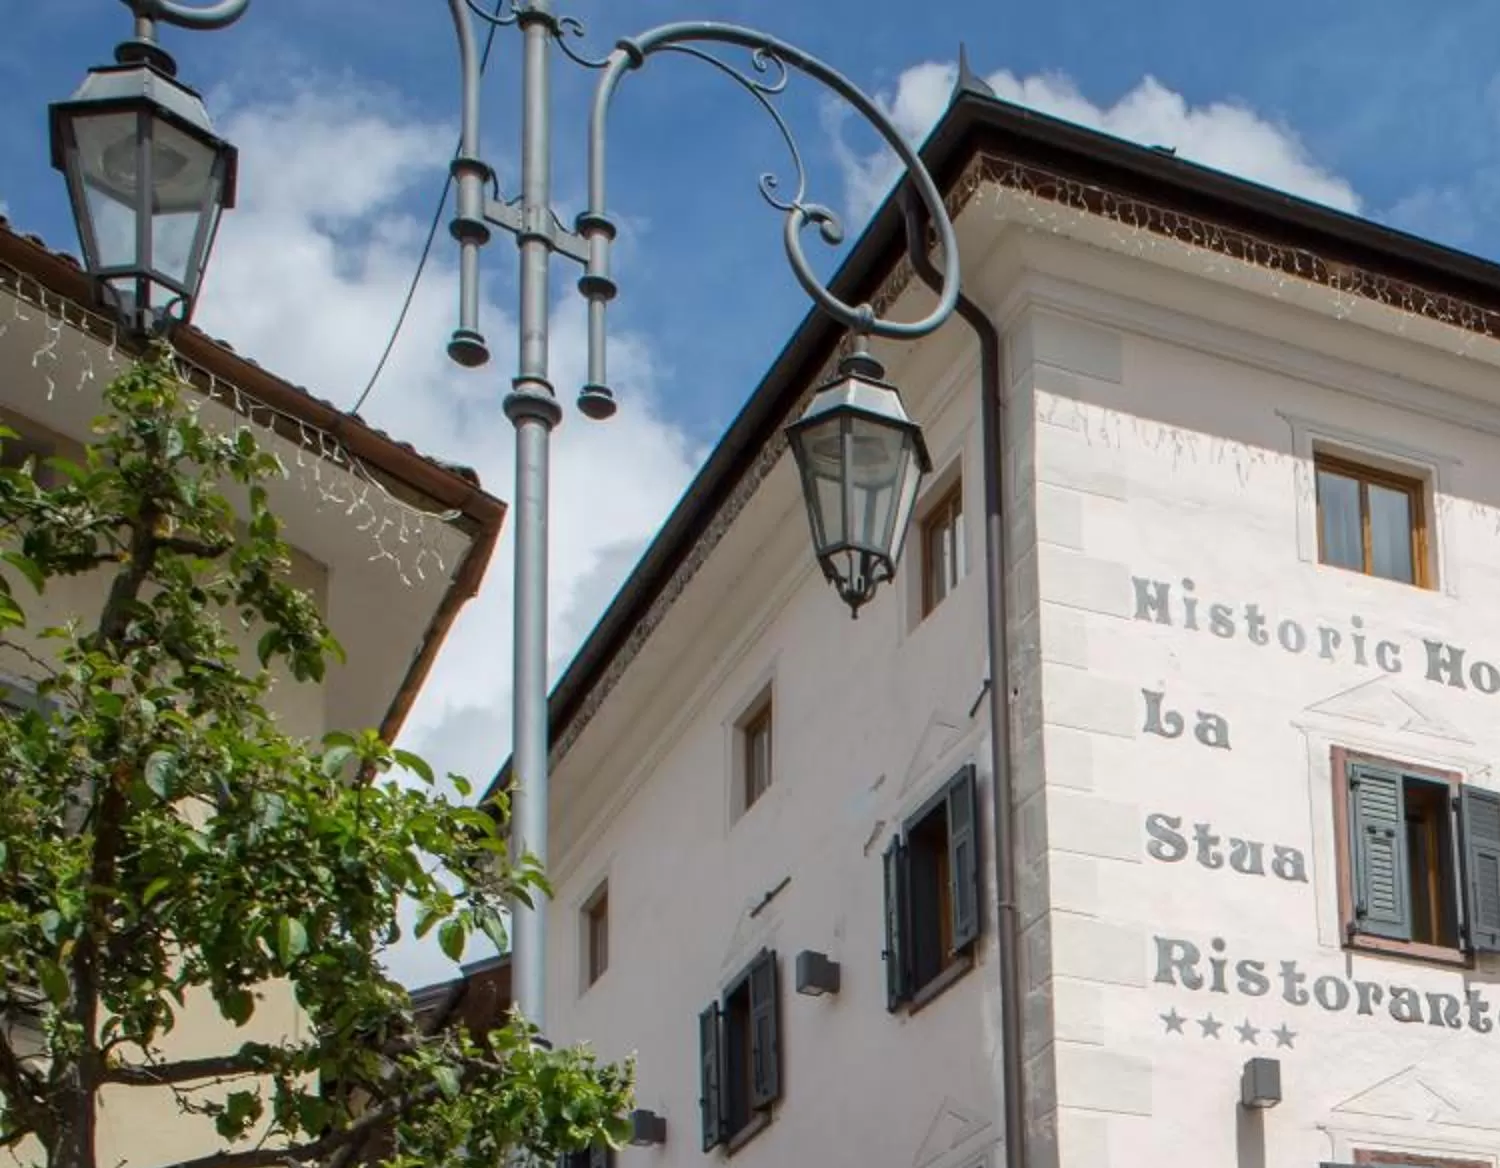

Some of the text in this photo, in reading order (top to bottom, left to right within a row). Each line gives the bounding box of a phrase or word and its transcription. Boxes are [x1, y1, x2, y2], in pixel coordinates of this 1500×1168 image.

[1131, 576, 1404, 674] Historic
[1142, 687, 1232, 750] La
[1144, 813, 1309, 884] Stua
